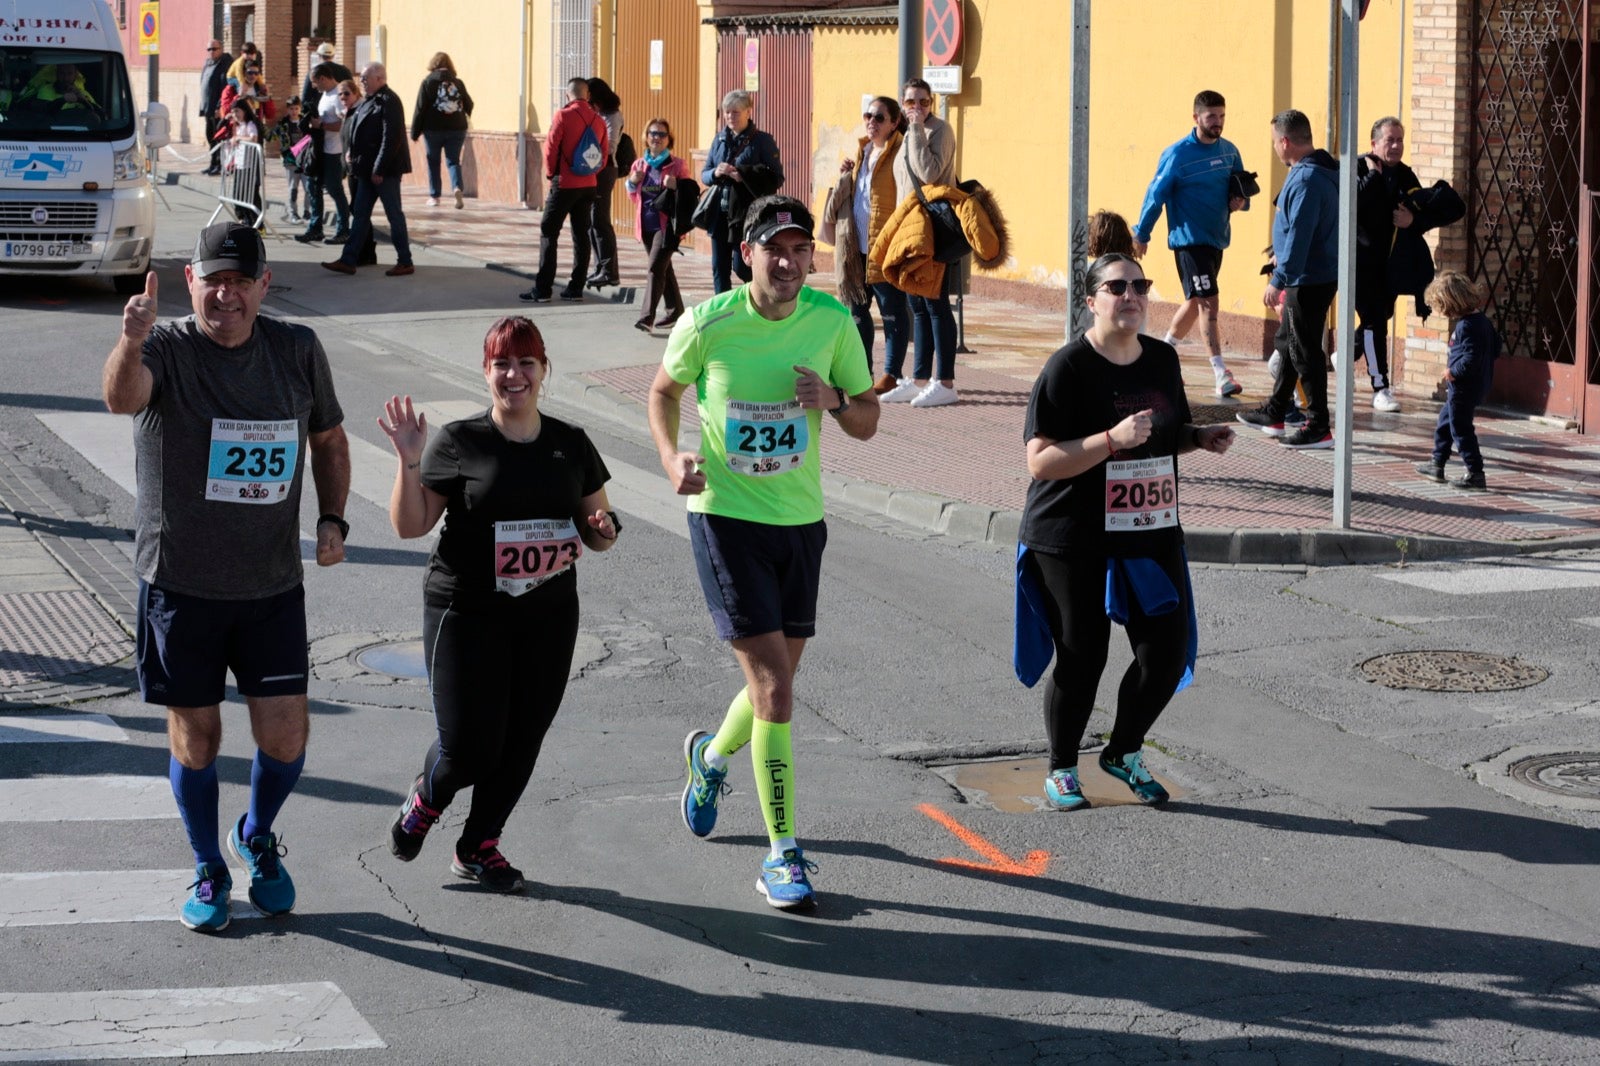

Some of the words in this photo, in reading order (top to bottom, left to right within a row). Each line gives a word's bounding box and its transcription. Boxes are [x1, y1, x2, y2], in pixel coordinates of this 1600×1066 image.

[13, 244, 44, 257] 0799
[48, 244, 70, 257] GZF
[1192, 274, 1211, 291] 25
[761, 403, 781, 412] PREMIO
[236, 422, 252, 432] GRAN
[252, 422, 273, 432] PREMIO
[273, 422, 281, 432] DE
[738, 424, 797, 453] 234
[224, 447, 286, 477] 235
[1110, 479, 1174, 509] 2056
[501, 542, 579, 575] 2073
[765, 759, 788, 833] kalenji
